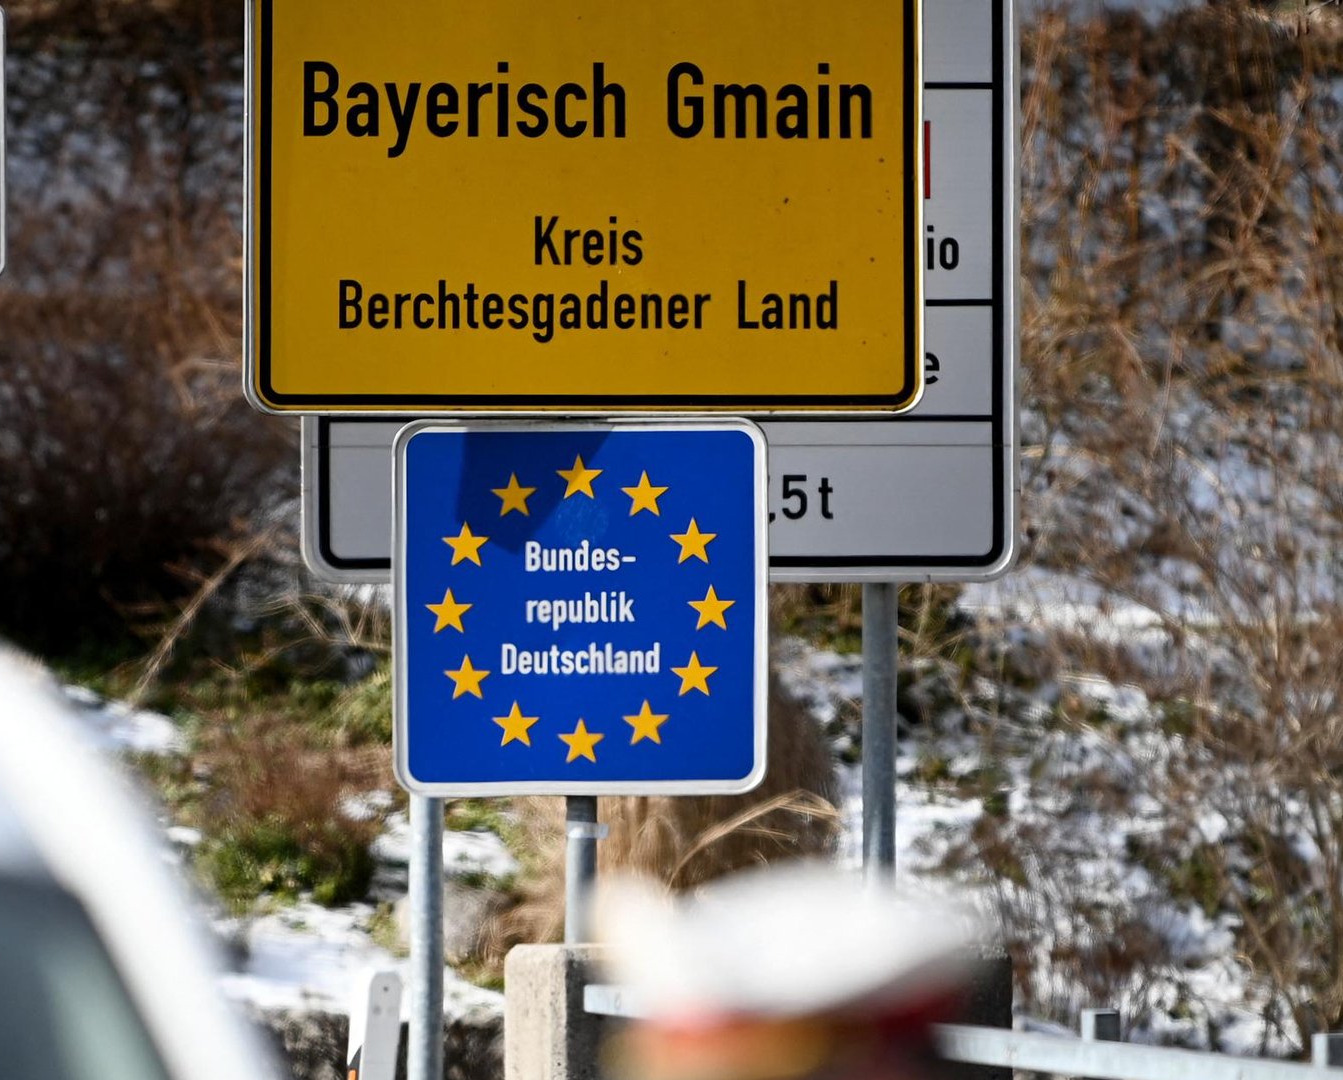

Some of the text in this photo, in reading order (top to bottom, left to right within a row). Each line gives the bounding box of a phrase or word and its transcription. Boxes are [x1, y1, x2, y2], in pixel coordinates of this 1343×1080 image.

[303, 60, 873, 159] Bayerisch Gmain
[534, 215, 643, 266] Kreis
[926, 224, 960, 270] io
[338, 279, 838, 344] Berchtesgadener Land
[925, 352, 940, 385] e
[769, 474, 834, 524] ,5 t
[525, 539, 637, 572] Bundes-
[525, 591, 636, 629] republik
[500, 642, 661, 675] Deutschland
